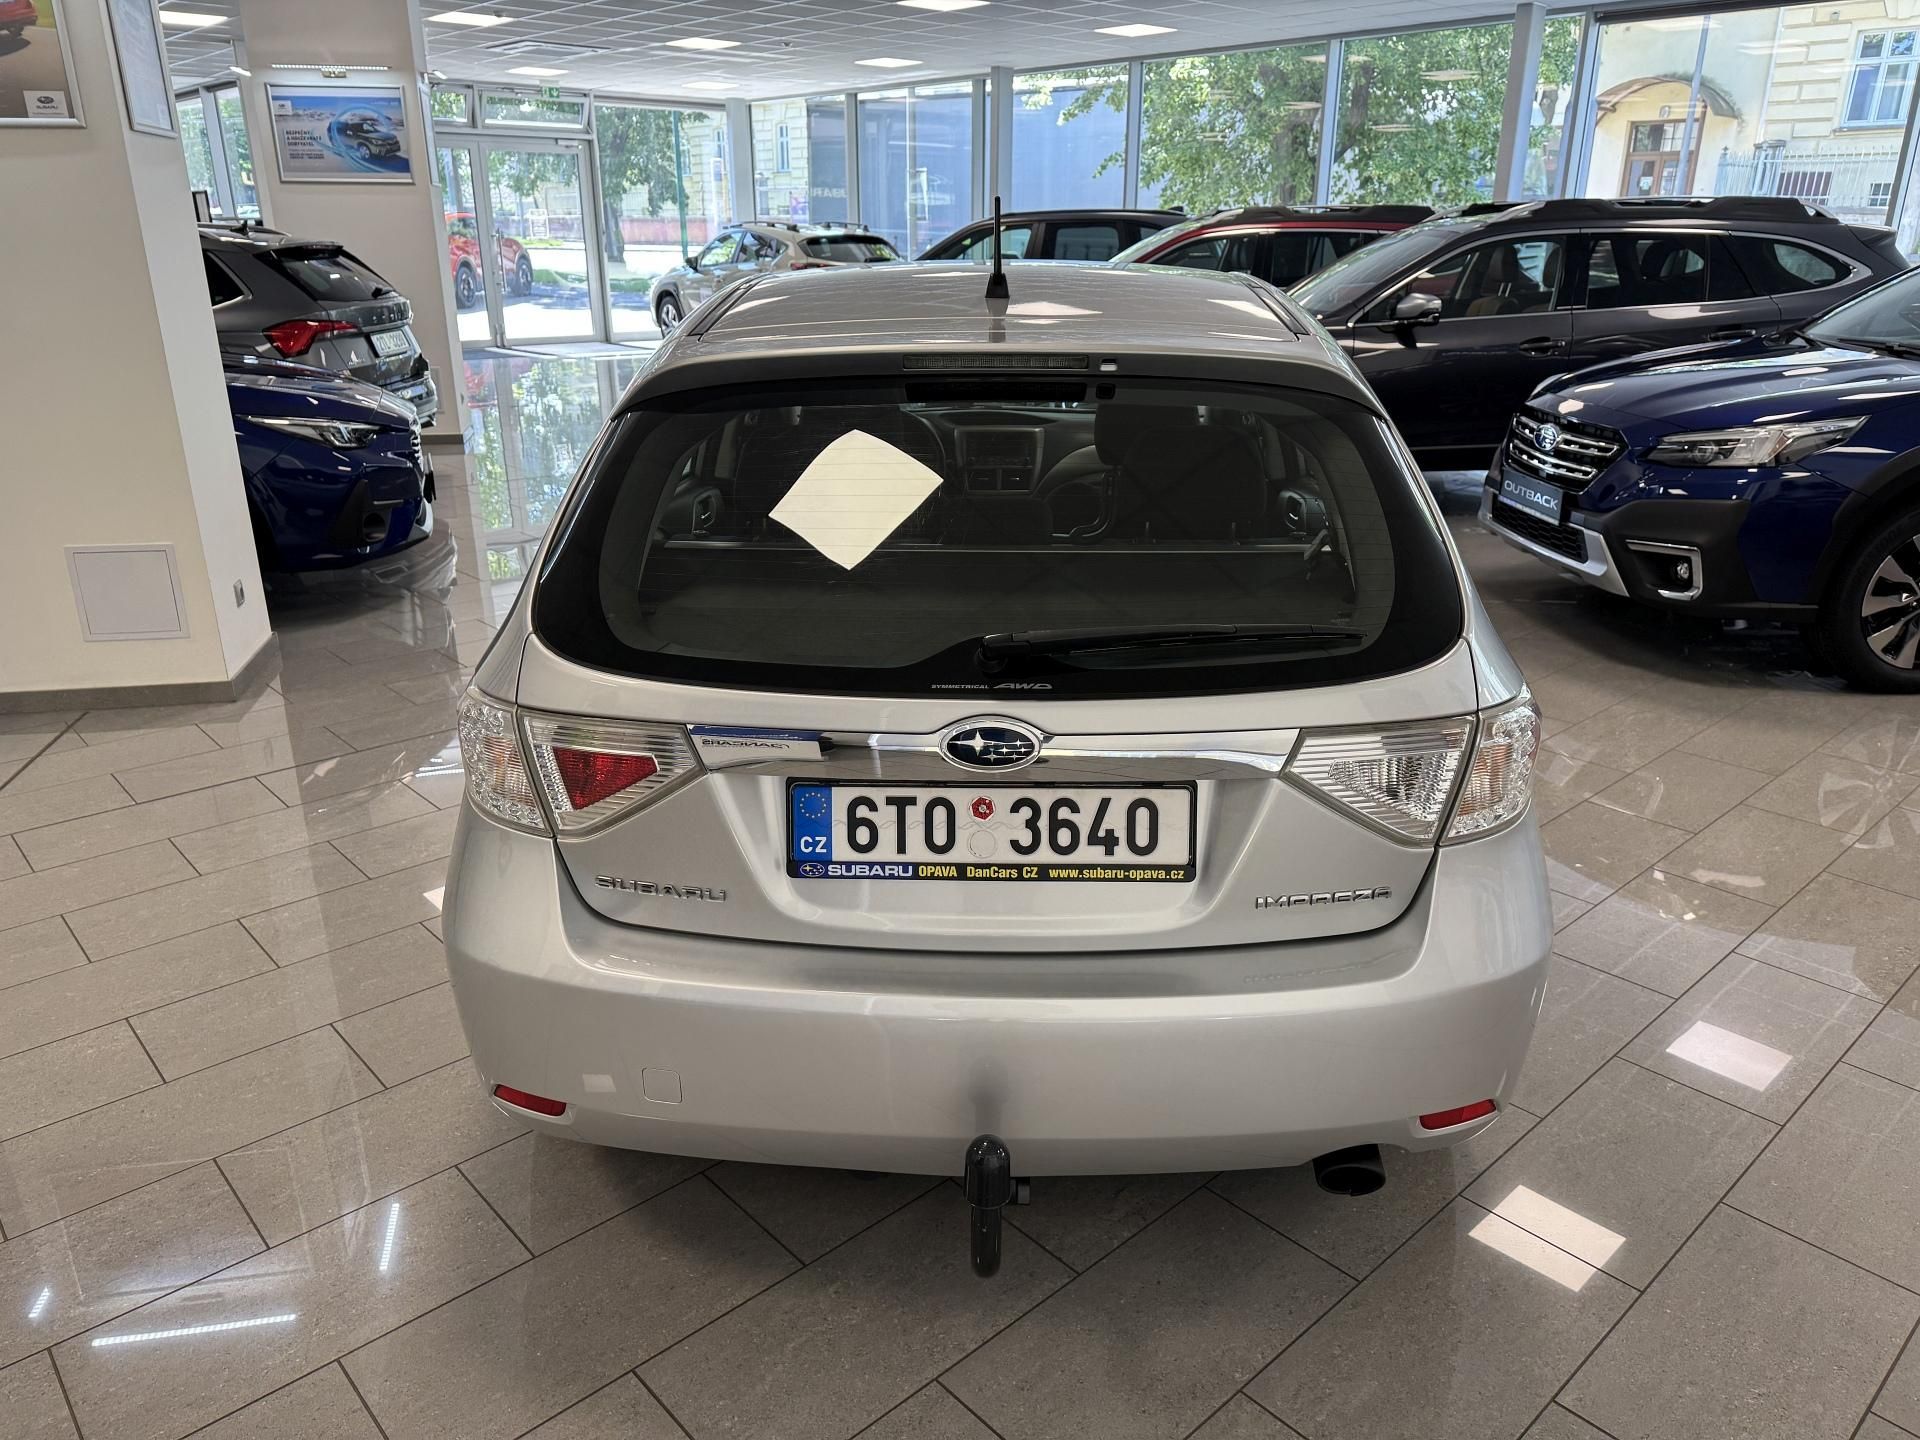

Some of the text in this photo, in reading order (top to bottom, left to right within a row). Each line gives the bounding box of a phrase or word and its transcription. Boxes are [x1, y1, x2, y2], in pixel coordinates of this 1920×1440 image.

[1504, 480, 1559, 511] OUTBACK
[993, 682, 1053, 690] AWD
[1009, 797, 1159, 856] 3640
[800, 836, 827, 853] CZ
[828, 864, 1185, 880] SUBARU OPAVA DanCars CZ www.subaru-opava.cz
[595, 875, 726, 902] SUBARU
[1255, 886, 1392, 909] IMPREZA
